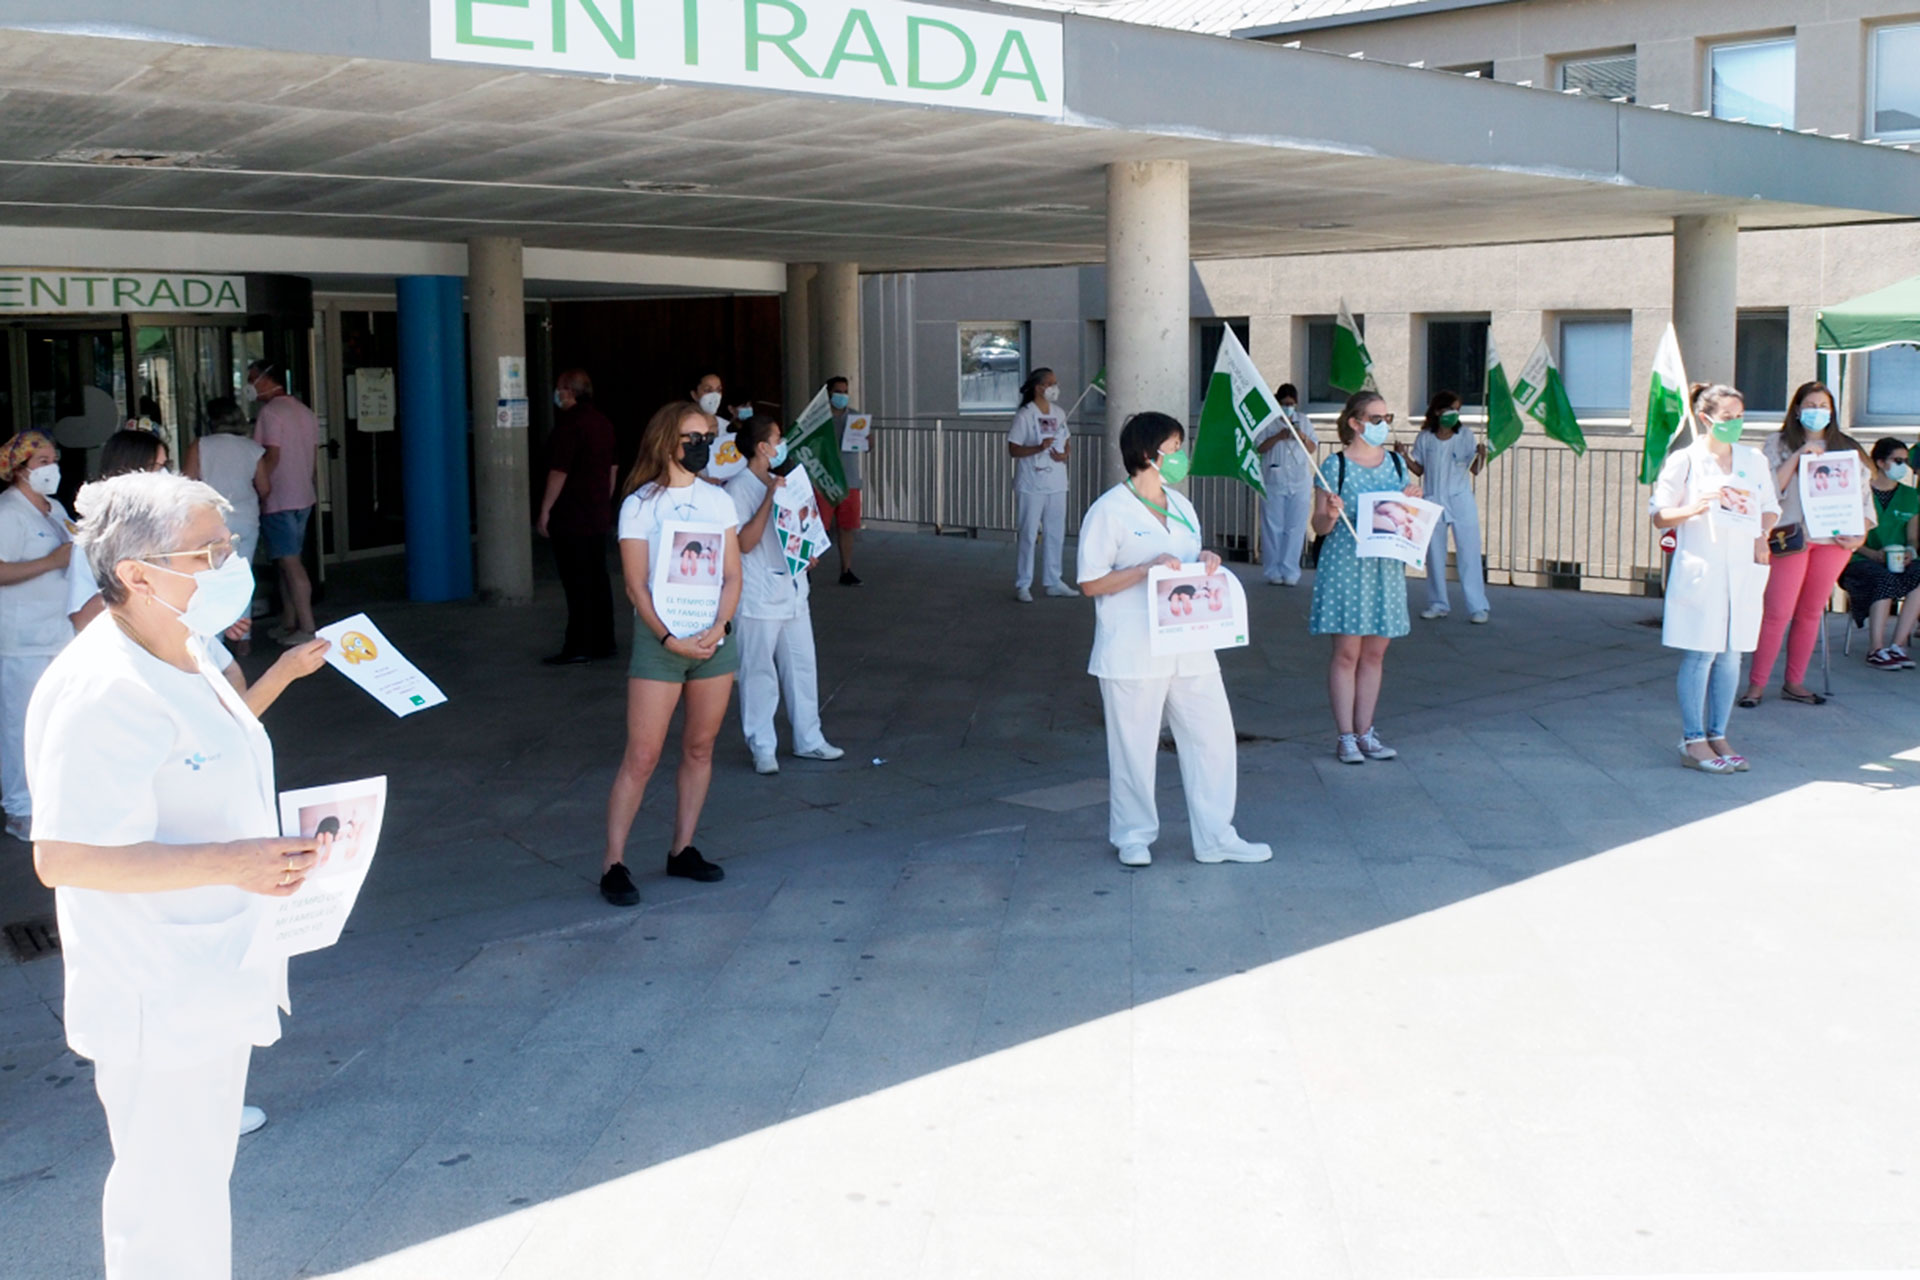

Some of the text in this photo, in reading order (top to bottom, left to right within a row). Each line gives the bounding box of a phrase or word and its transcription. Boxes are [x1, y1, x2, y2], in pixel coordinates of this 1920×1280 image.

[455, 0, 1048, 102] ENTRADA
[0, 277, 241, 308] ENTRADA
[796, 445, 844, 501] SATSE
